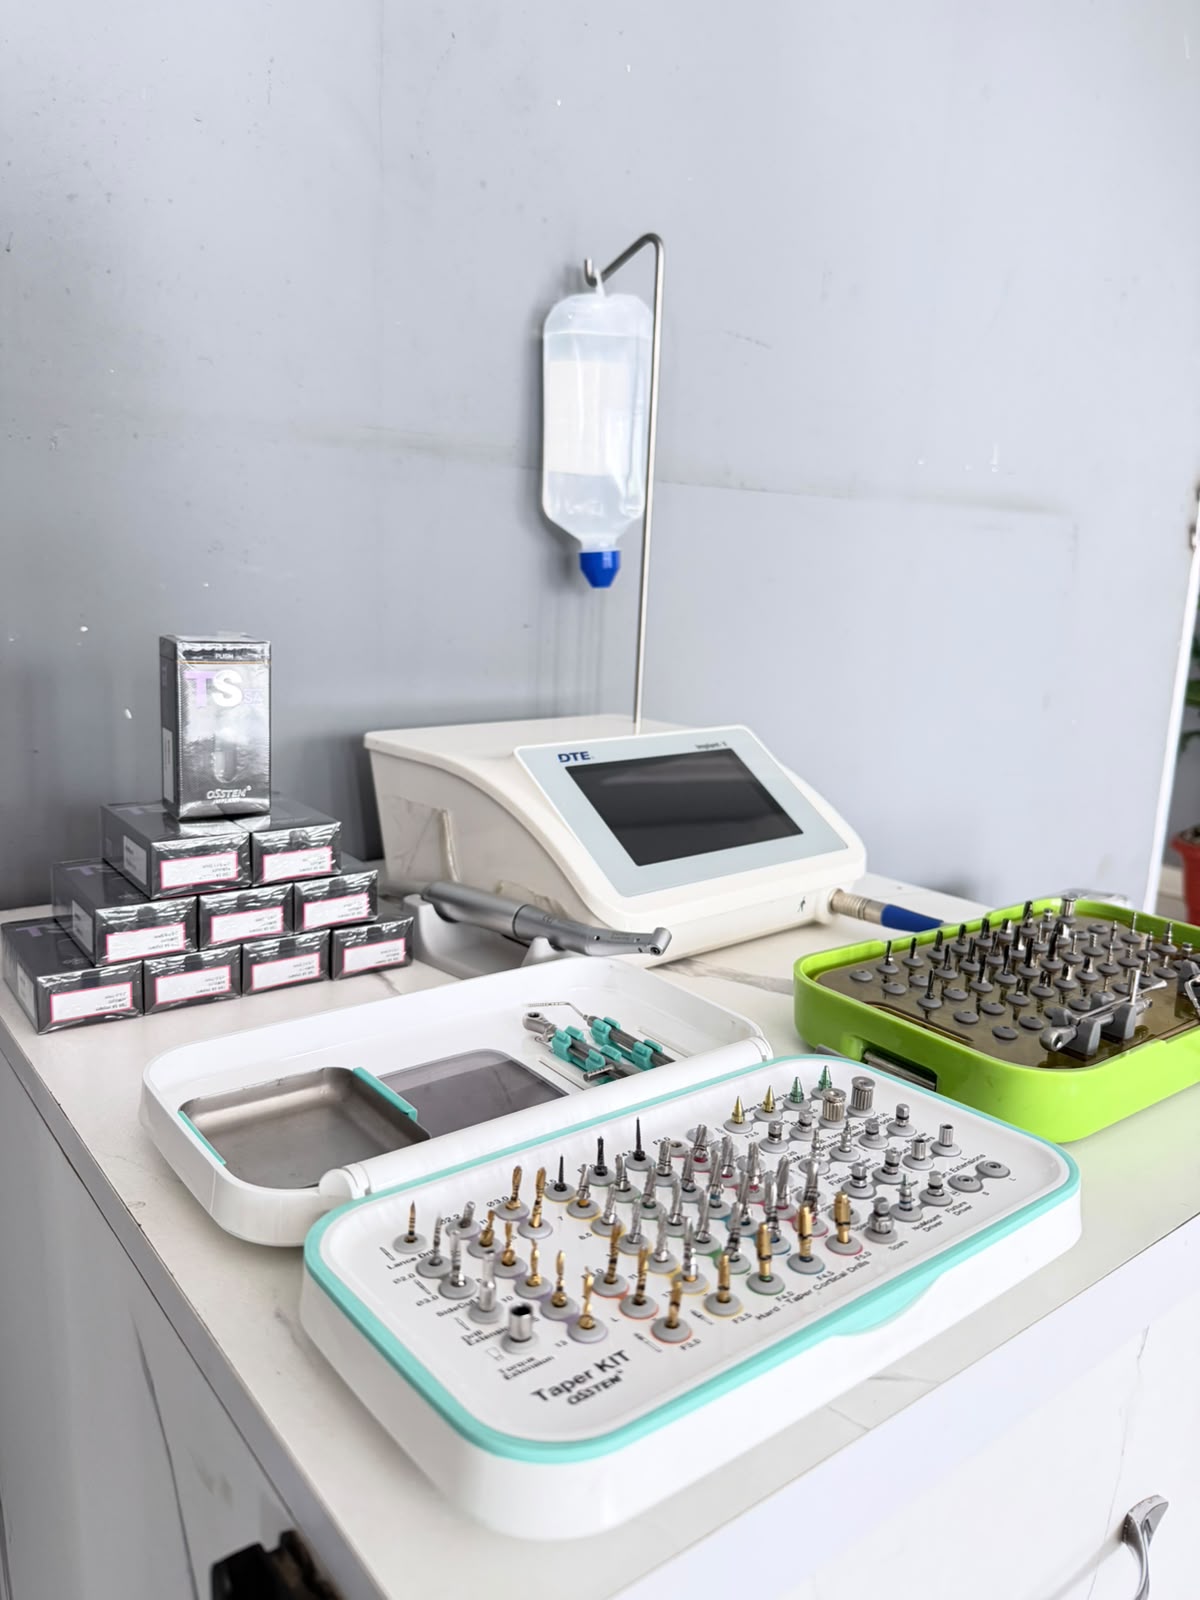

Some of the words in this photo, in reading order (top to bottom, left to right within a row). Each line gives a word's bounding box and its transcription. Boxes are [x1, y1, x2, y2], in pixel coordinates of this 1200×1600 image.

[184, 669, 242, 708] TS
[558, 751, 591, 763] DTE
[531, 1370, 593, 1402] Taper
[594, 1350, 631, 1374] KIT
